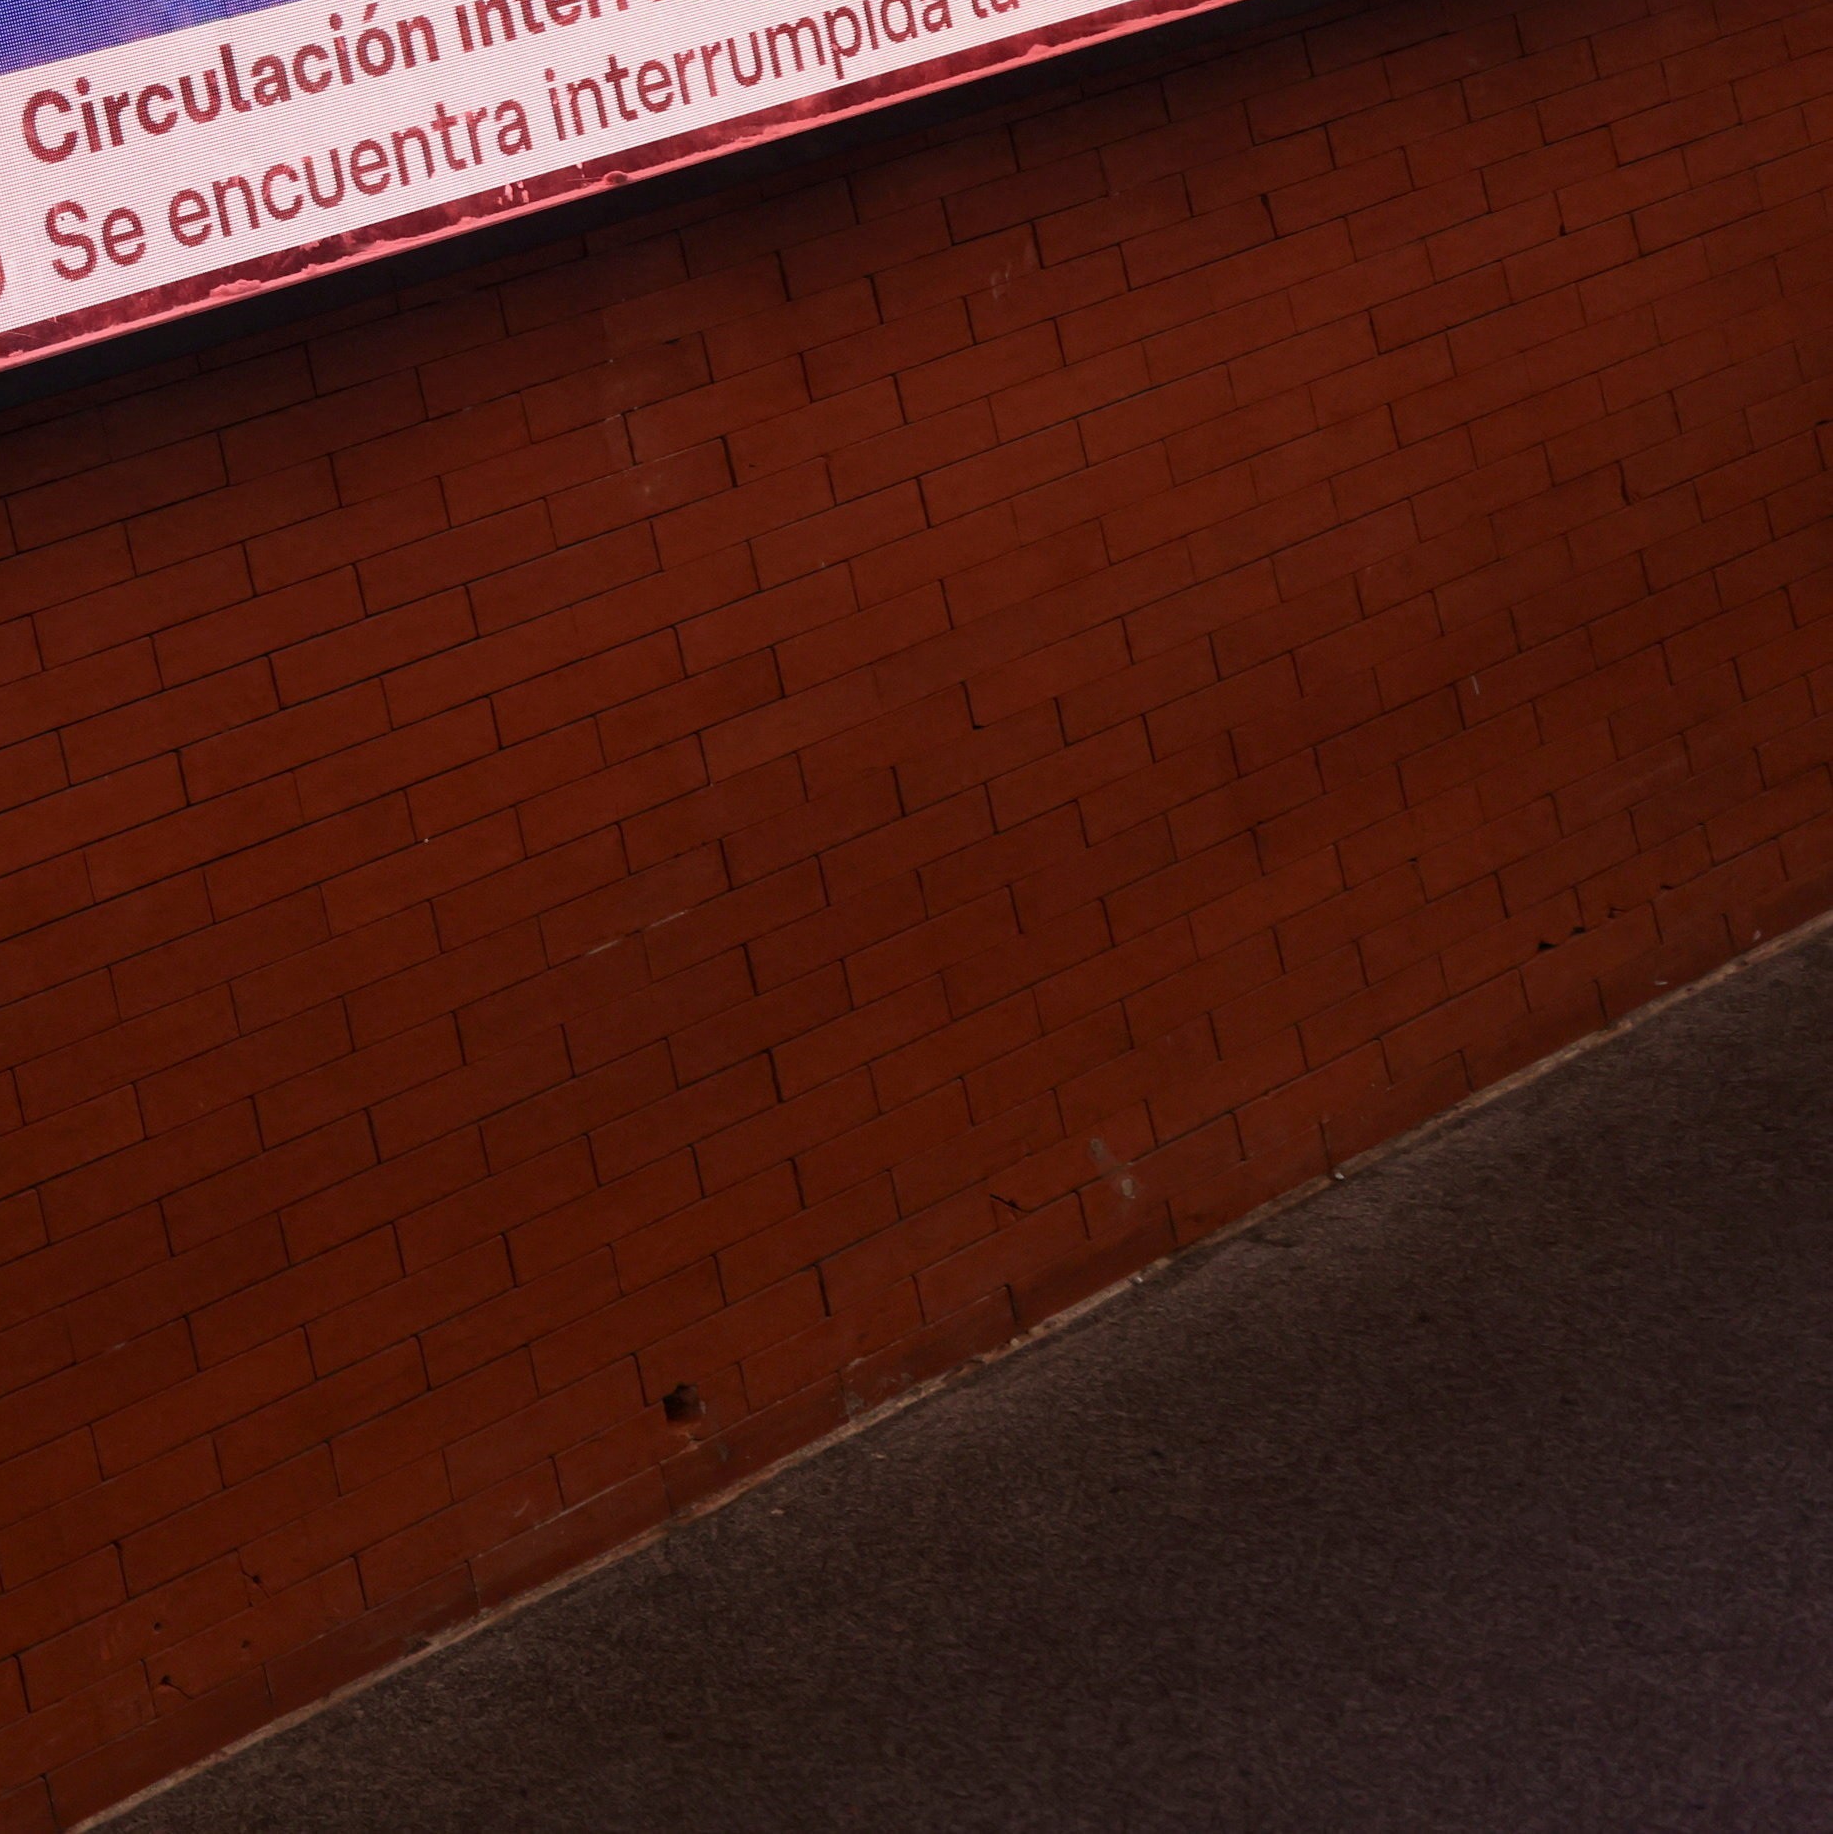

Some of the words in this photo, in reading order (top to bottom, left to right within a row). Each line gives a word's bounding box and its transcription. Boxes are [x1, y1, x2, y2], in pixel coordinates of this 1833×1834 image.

[22, 3, 440, 164] Circulación
[45, 199, 148, 283] Se
[168, 98, 533, 247] encuentra
